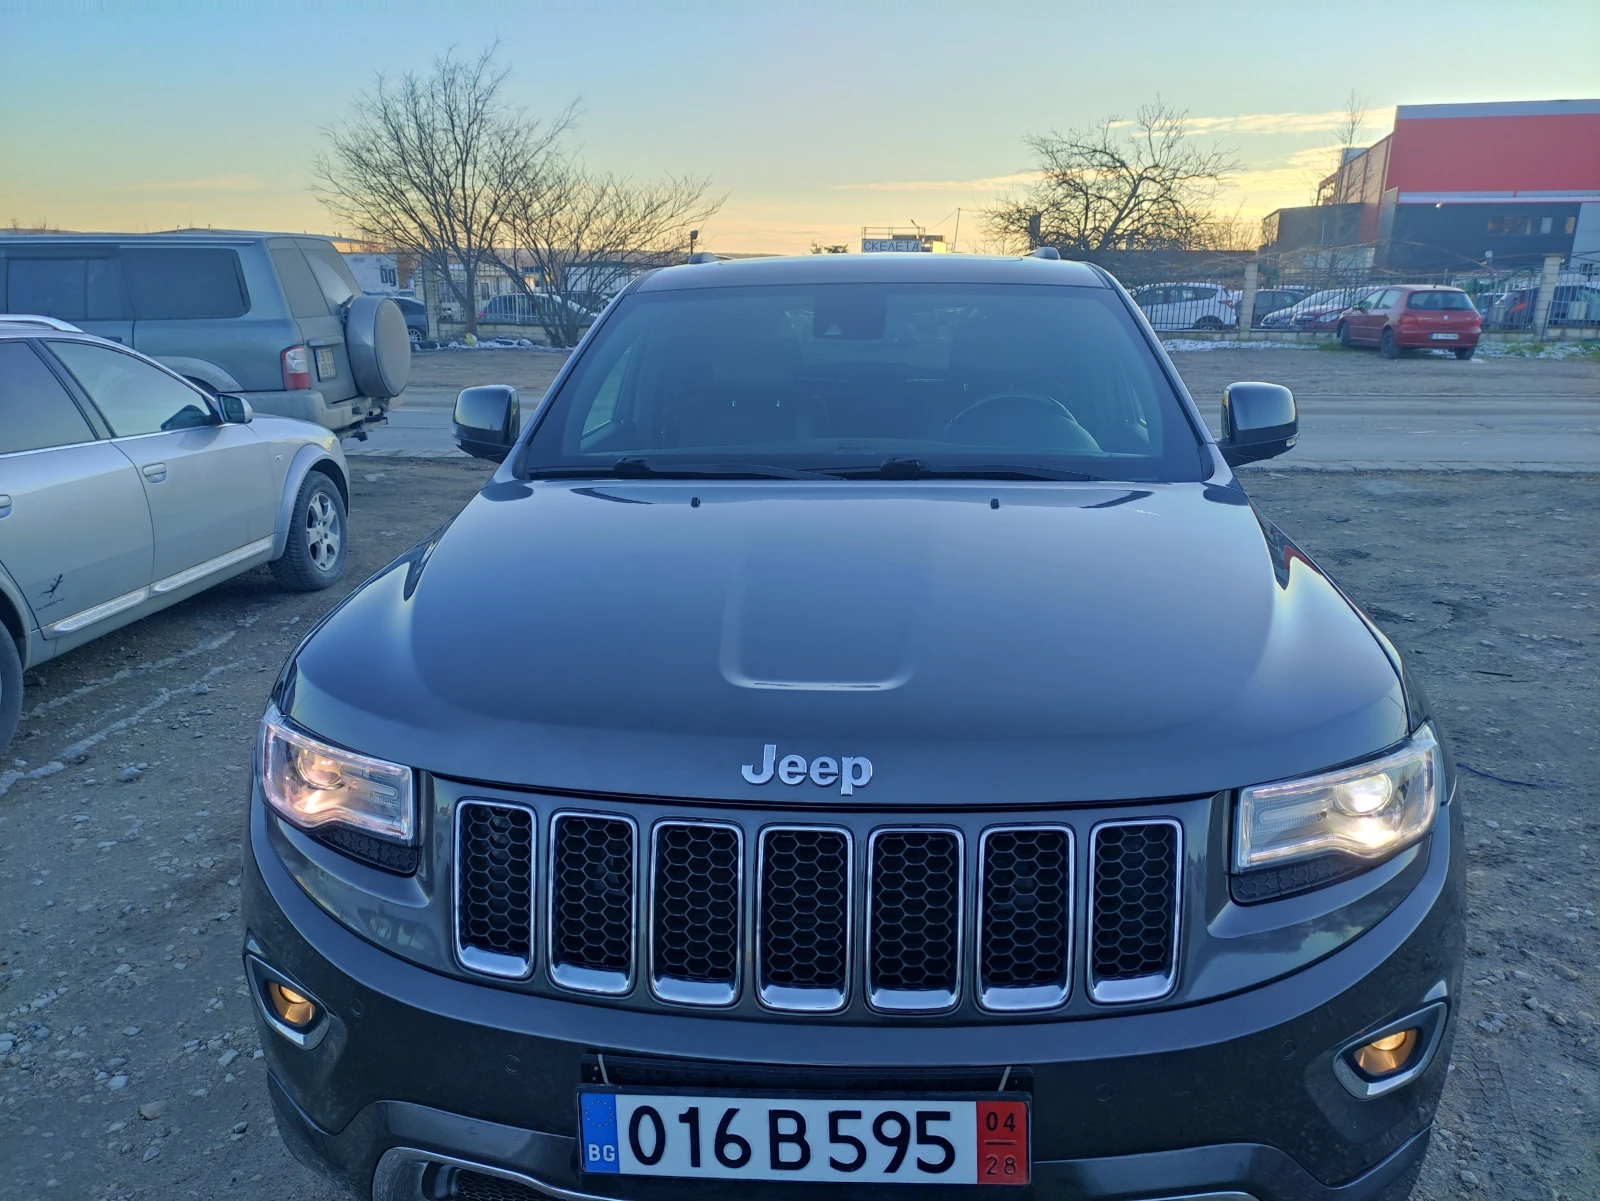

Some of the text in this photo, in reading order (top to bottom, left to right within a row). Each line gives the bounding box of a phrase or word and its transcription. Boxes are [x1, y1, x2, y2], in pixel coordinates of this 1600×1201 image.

[741, 744, 873, 796] Jeep
[985, 1111, 1016, 1132] 04
[588, 1143, 616, 1162] BG
[985, 1153, 1017, 1175] 28
